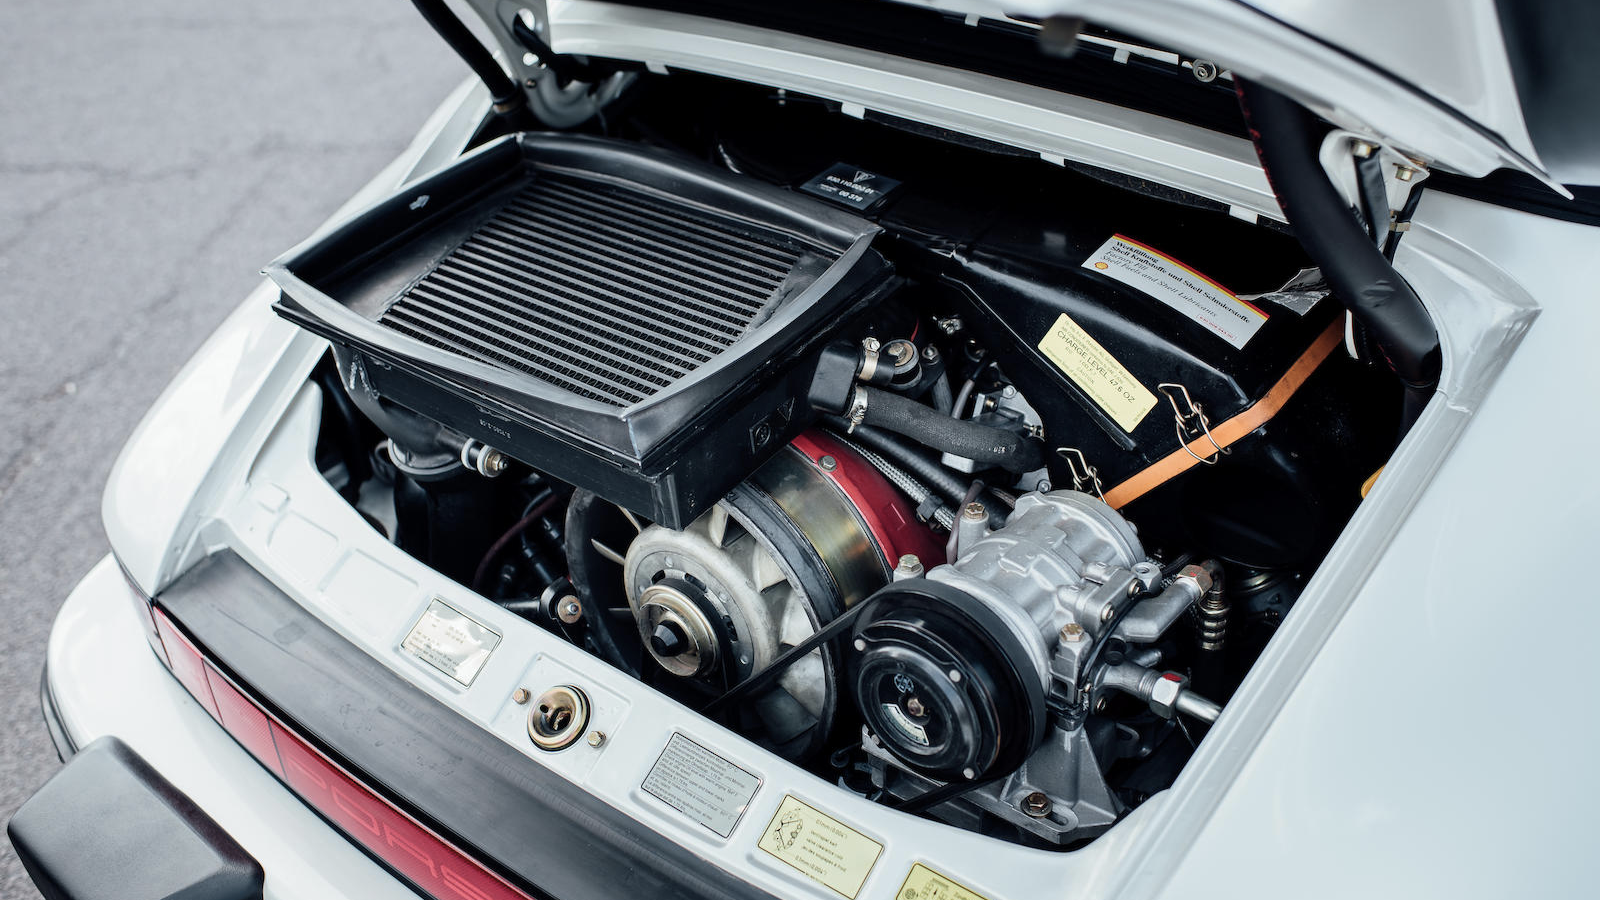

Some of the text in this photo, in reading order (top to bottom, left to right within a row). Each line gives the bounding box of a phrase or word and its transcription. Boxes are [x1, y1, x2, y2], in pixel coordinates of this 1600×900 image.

[1101, 255, 1217, 317] Shell Fuels and Shell Lubricants
[1111, 246, 1130, 256] Shell
[1168, 272, 1183, 282] und
[1183, 280, 1203, 294] Shell
[1134, 262, 1149, 271] Fill
[1057, 331, 1088, 359] CHARGE
[1087, 357, 1109, 379] LEVEL
[1123, 392, 1135, 403] OZ
